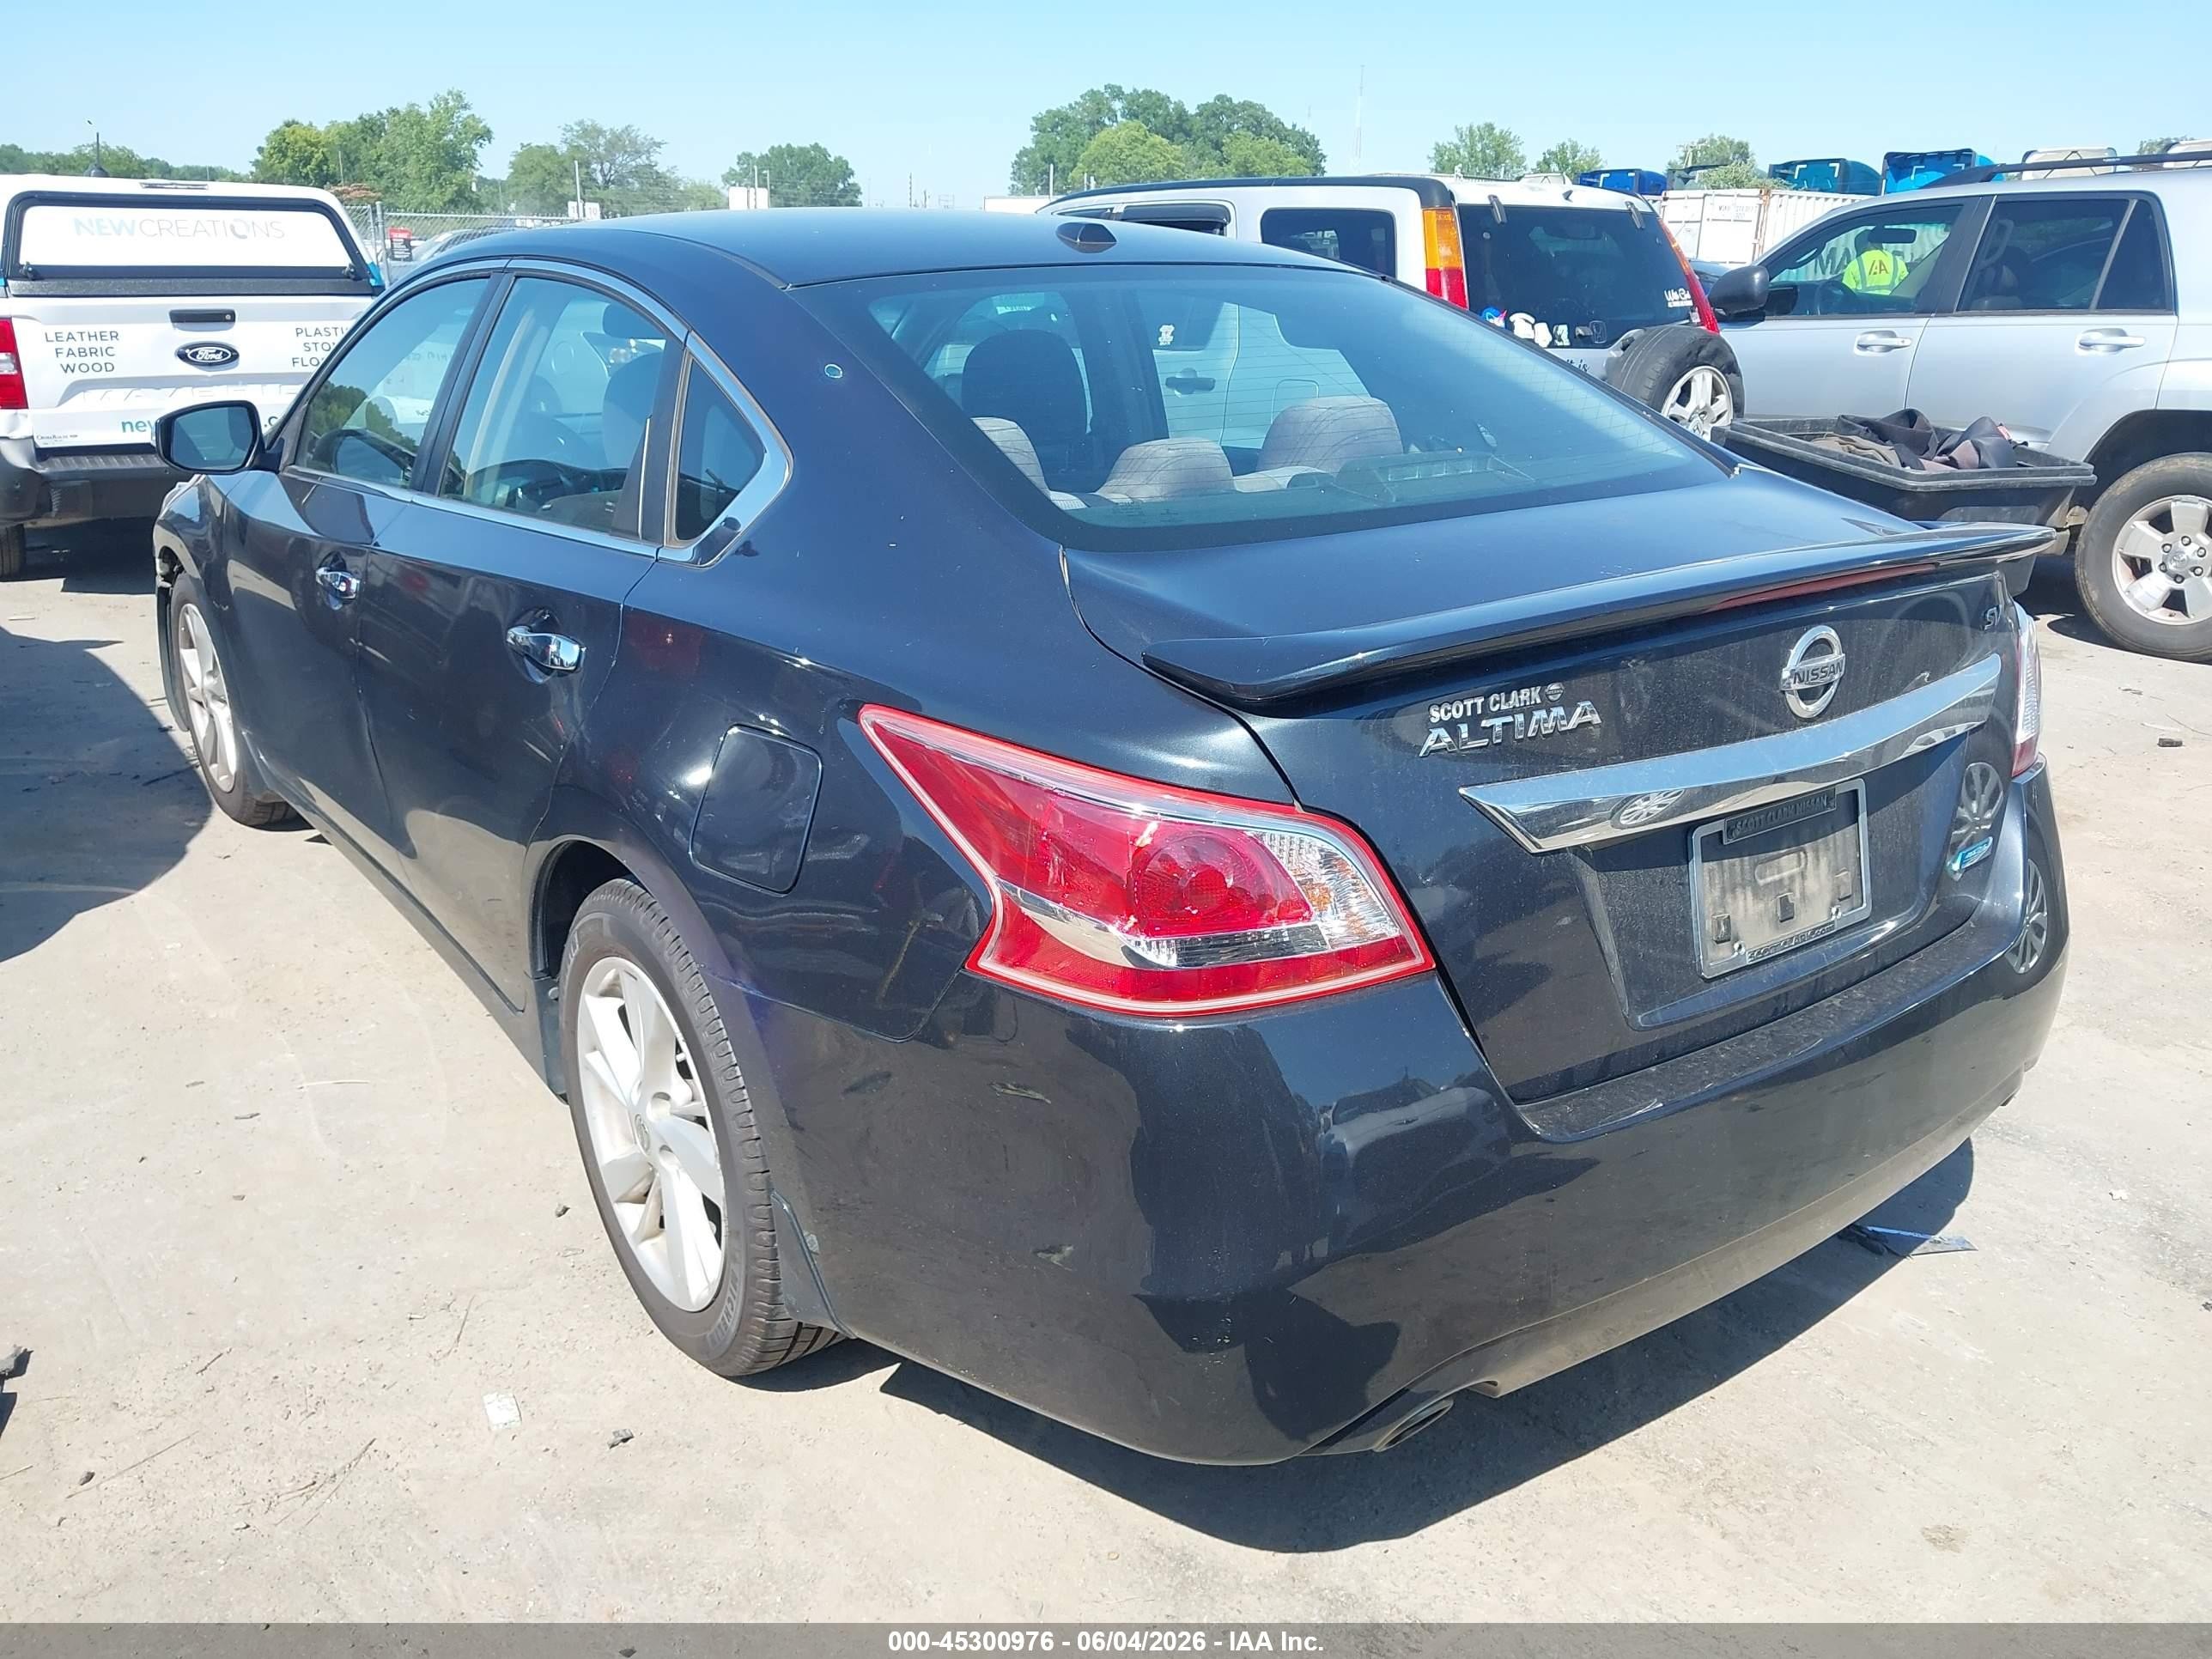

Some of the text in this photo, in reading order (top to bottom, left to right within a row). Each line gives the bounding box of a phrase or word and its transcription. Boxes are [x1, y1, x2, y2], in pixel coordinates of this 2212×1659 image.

[45, 330, 120, 343] LEATHER
[295, 327, 348, 337] PLASTI
[54, 346, 116, 358] FABRIC
[302, 342, 336, 352] STO
[196, 349, 223, 361] Ford
[291, 356, 325, 367] FLO
[60, 362, 116, 374] WOOD
[1792, 661, 1844, 684] NISSAN
[1428, 685, 1542, 723] SCOTT CLARK
[1419, 700, 1602, 758] ALTIMA
